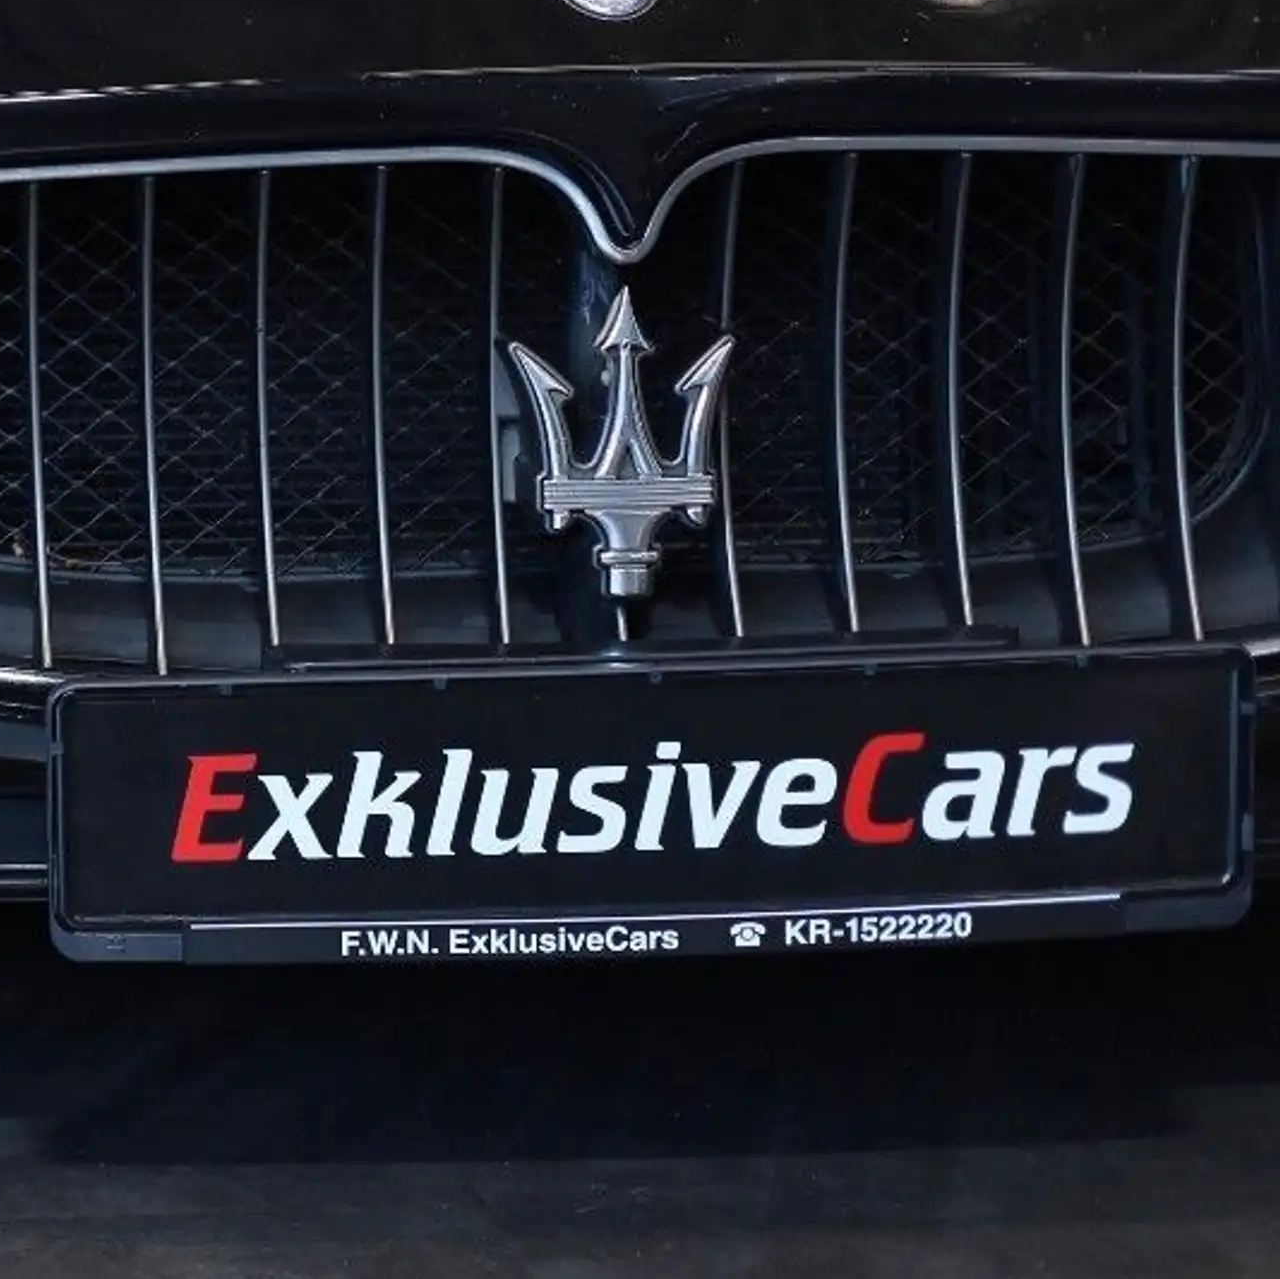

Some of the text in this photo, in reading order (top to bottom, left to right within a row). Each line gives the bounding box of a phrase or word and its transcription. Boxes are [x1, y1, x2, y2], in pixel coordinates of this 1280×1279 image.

[172, 733, 1134, 861] ExklusiveCars
[340, 912, 973, 957] F.W.N. ExklusiveCars KR-1522220
